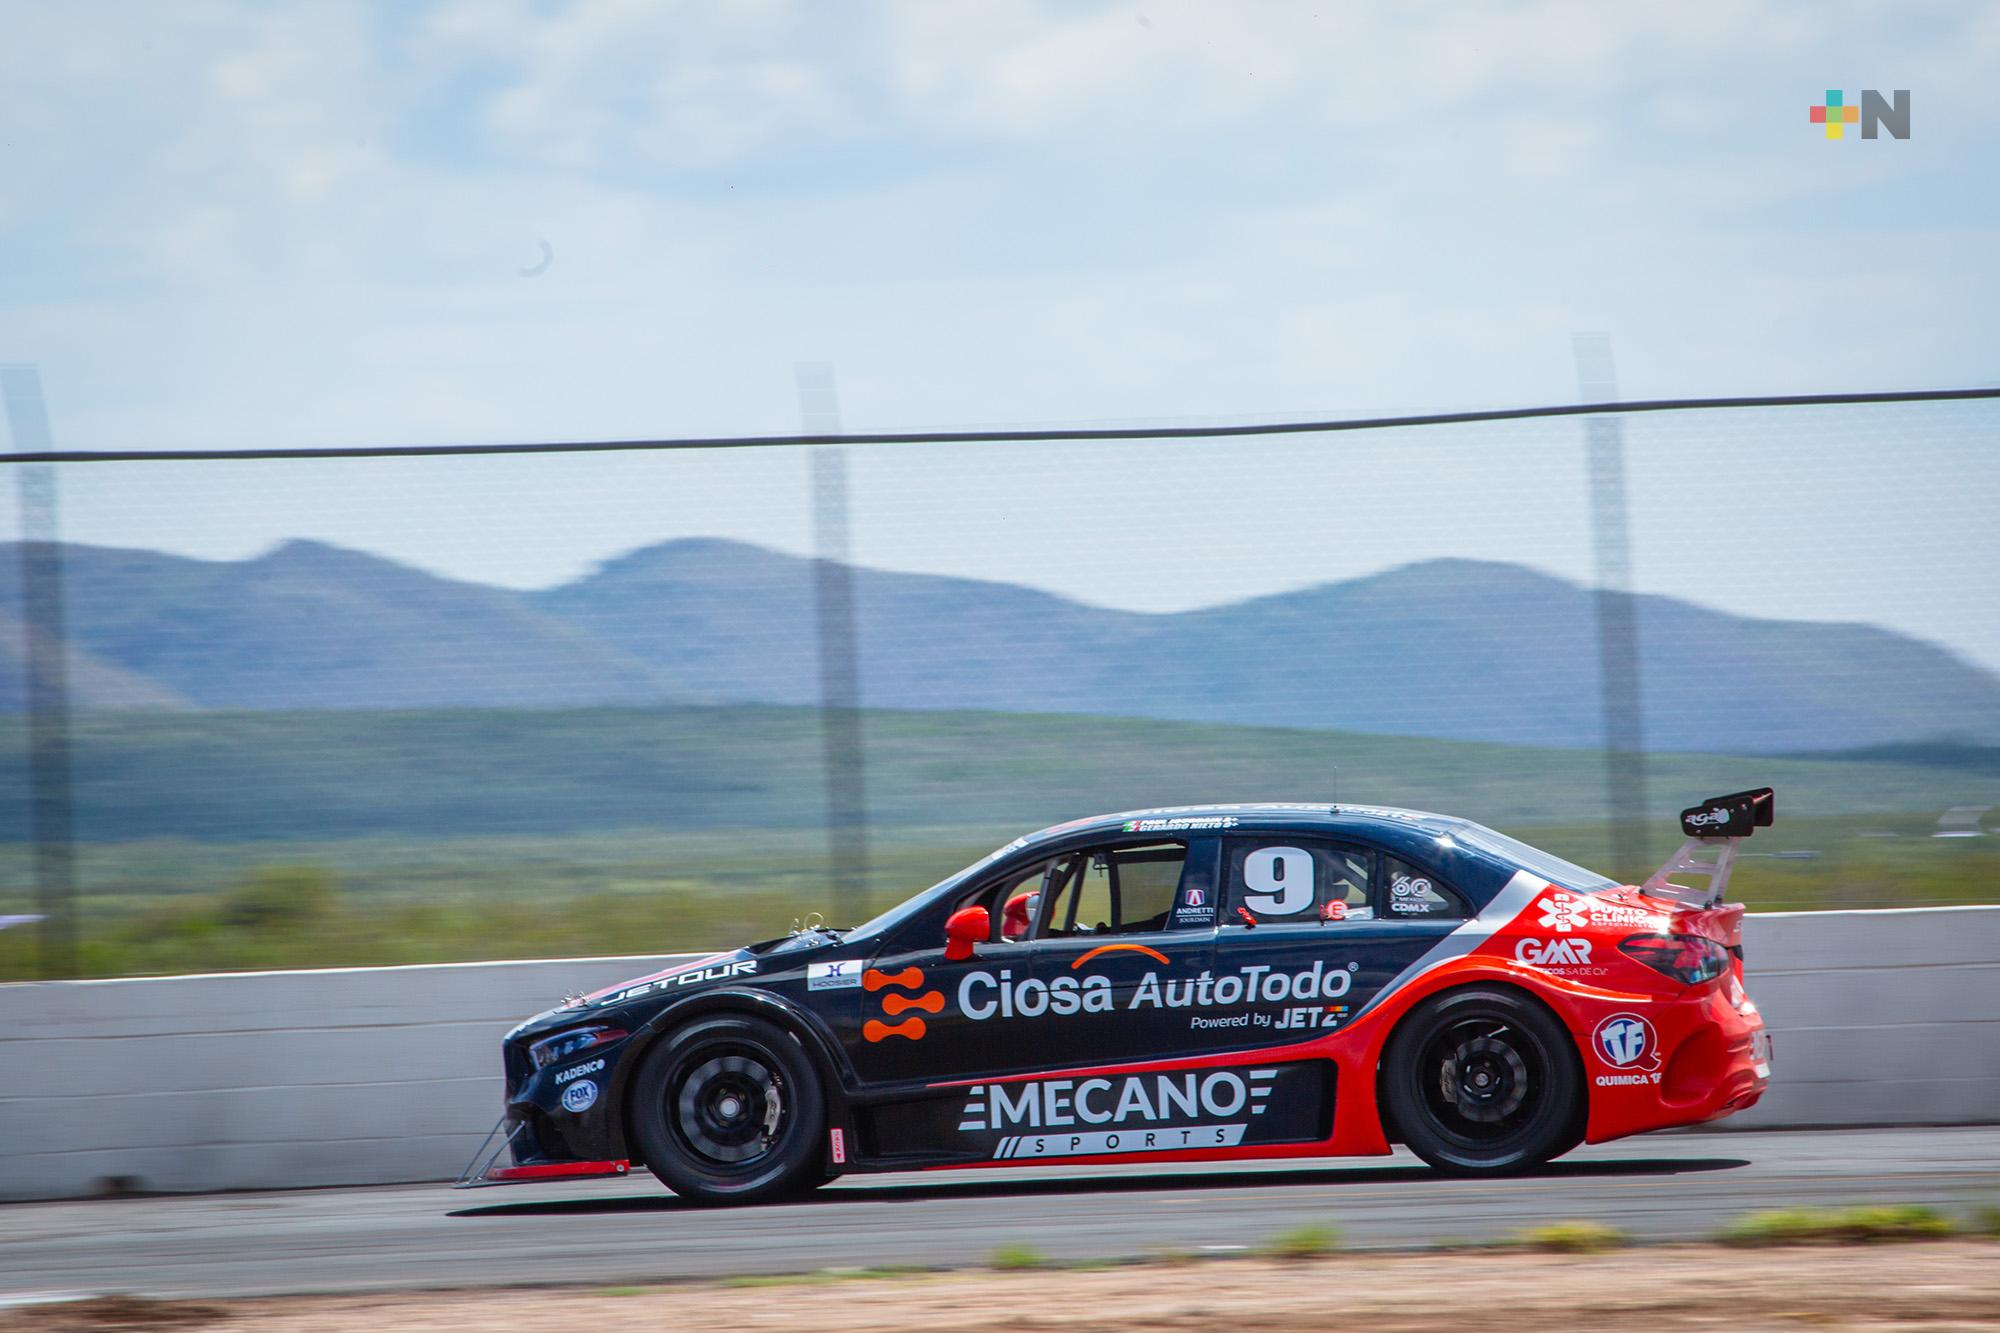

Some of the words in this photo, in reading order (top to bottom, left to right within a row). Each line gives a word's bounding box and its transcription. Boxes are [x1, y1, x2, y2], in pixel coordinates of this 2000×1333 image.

[1244, 846, 1315, 915] 9
[1391, 876, 1432, 897] 60
[1176, 907, 1214, 915] ANDRETTI
[1391, 903, 1430, 912] CDMX
[1590, 903, 1648, 917] PUNTO
[1590, 913, 1661, 924] CLÍNIC
[1515, 938, 1592, 965] GMR
[601, 960, 758, 1006] JETOUR
[958, 970, 1115, 1021] Ciosa
[1191, 1013, 1249, 1029] Powered
[1253, 1013, 1271, 1027] by
[1595, 1074, 1649, 1087] QUIMICA
[570, 1085, 590, 1102] FOX
[989, 1071, 1247, 1129] MECANO
[1034, 1128, 1226, 1153] SPORTS
